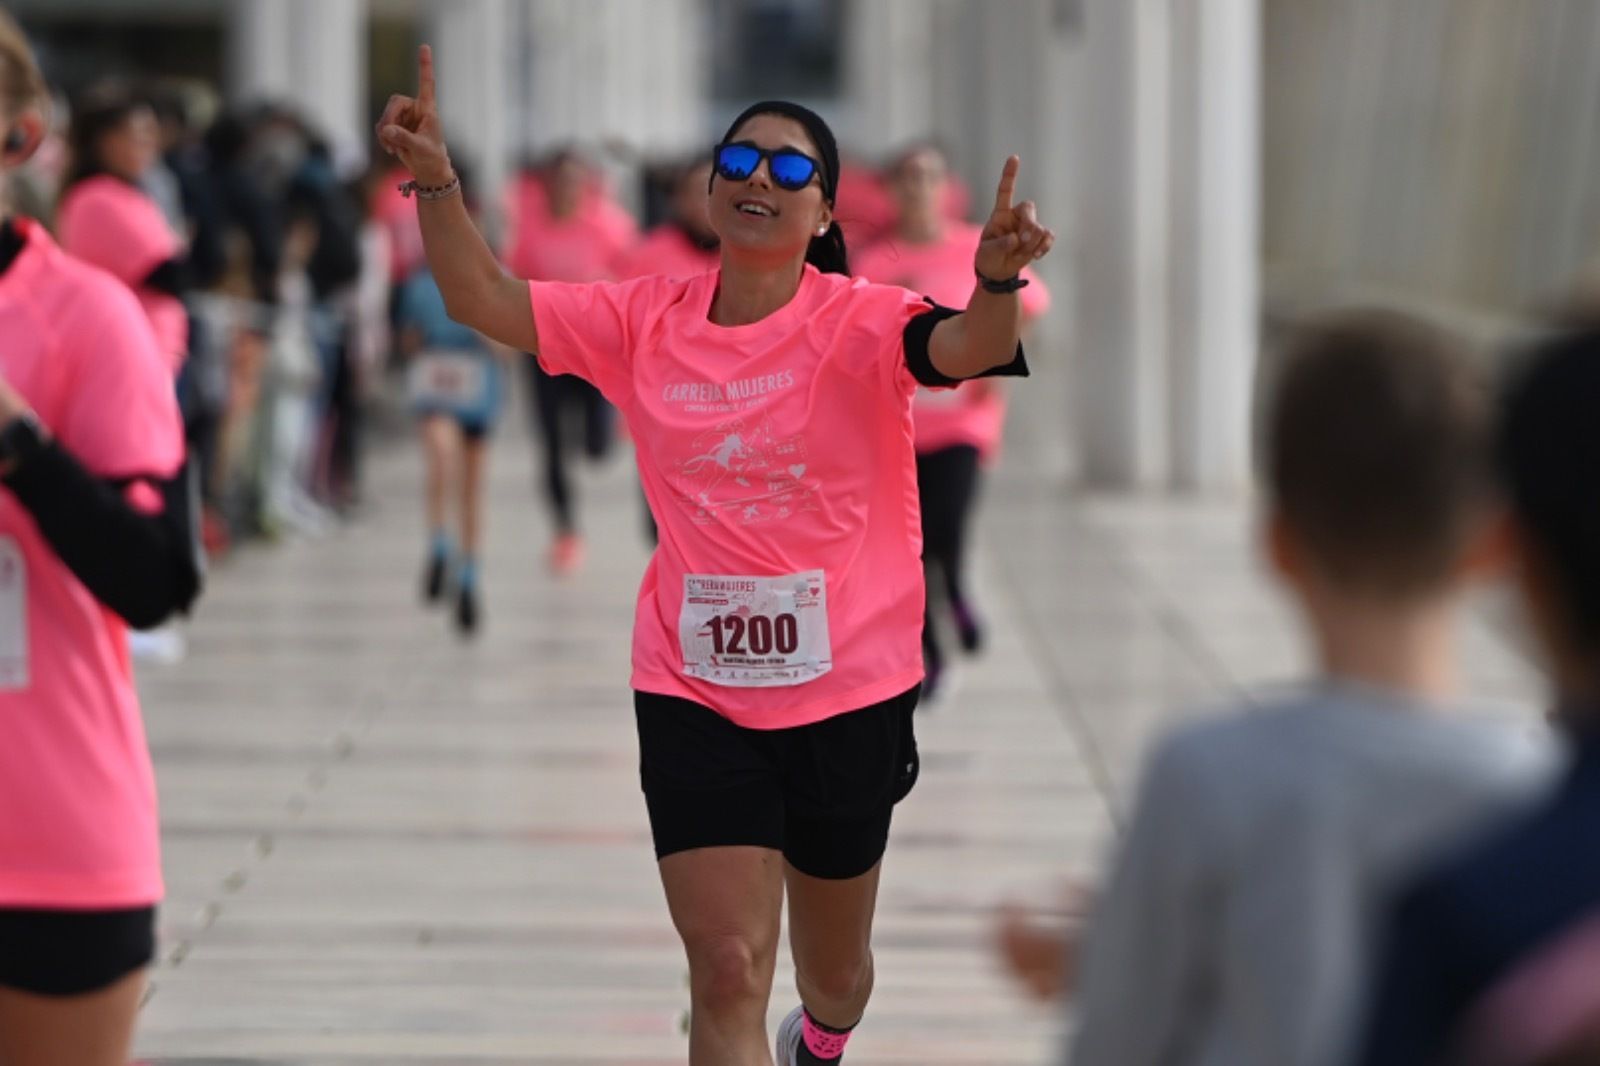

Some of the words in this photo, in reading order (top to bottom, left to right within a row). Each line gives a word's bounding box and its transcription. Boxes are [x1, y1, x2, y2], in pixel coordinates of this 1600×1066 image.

[726, 369, 795, 401] MUJERES
[688, 578, 756, 593] CRERAMUJERES
[709, 612, 799, 655] 1200
